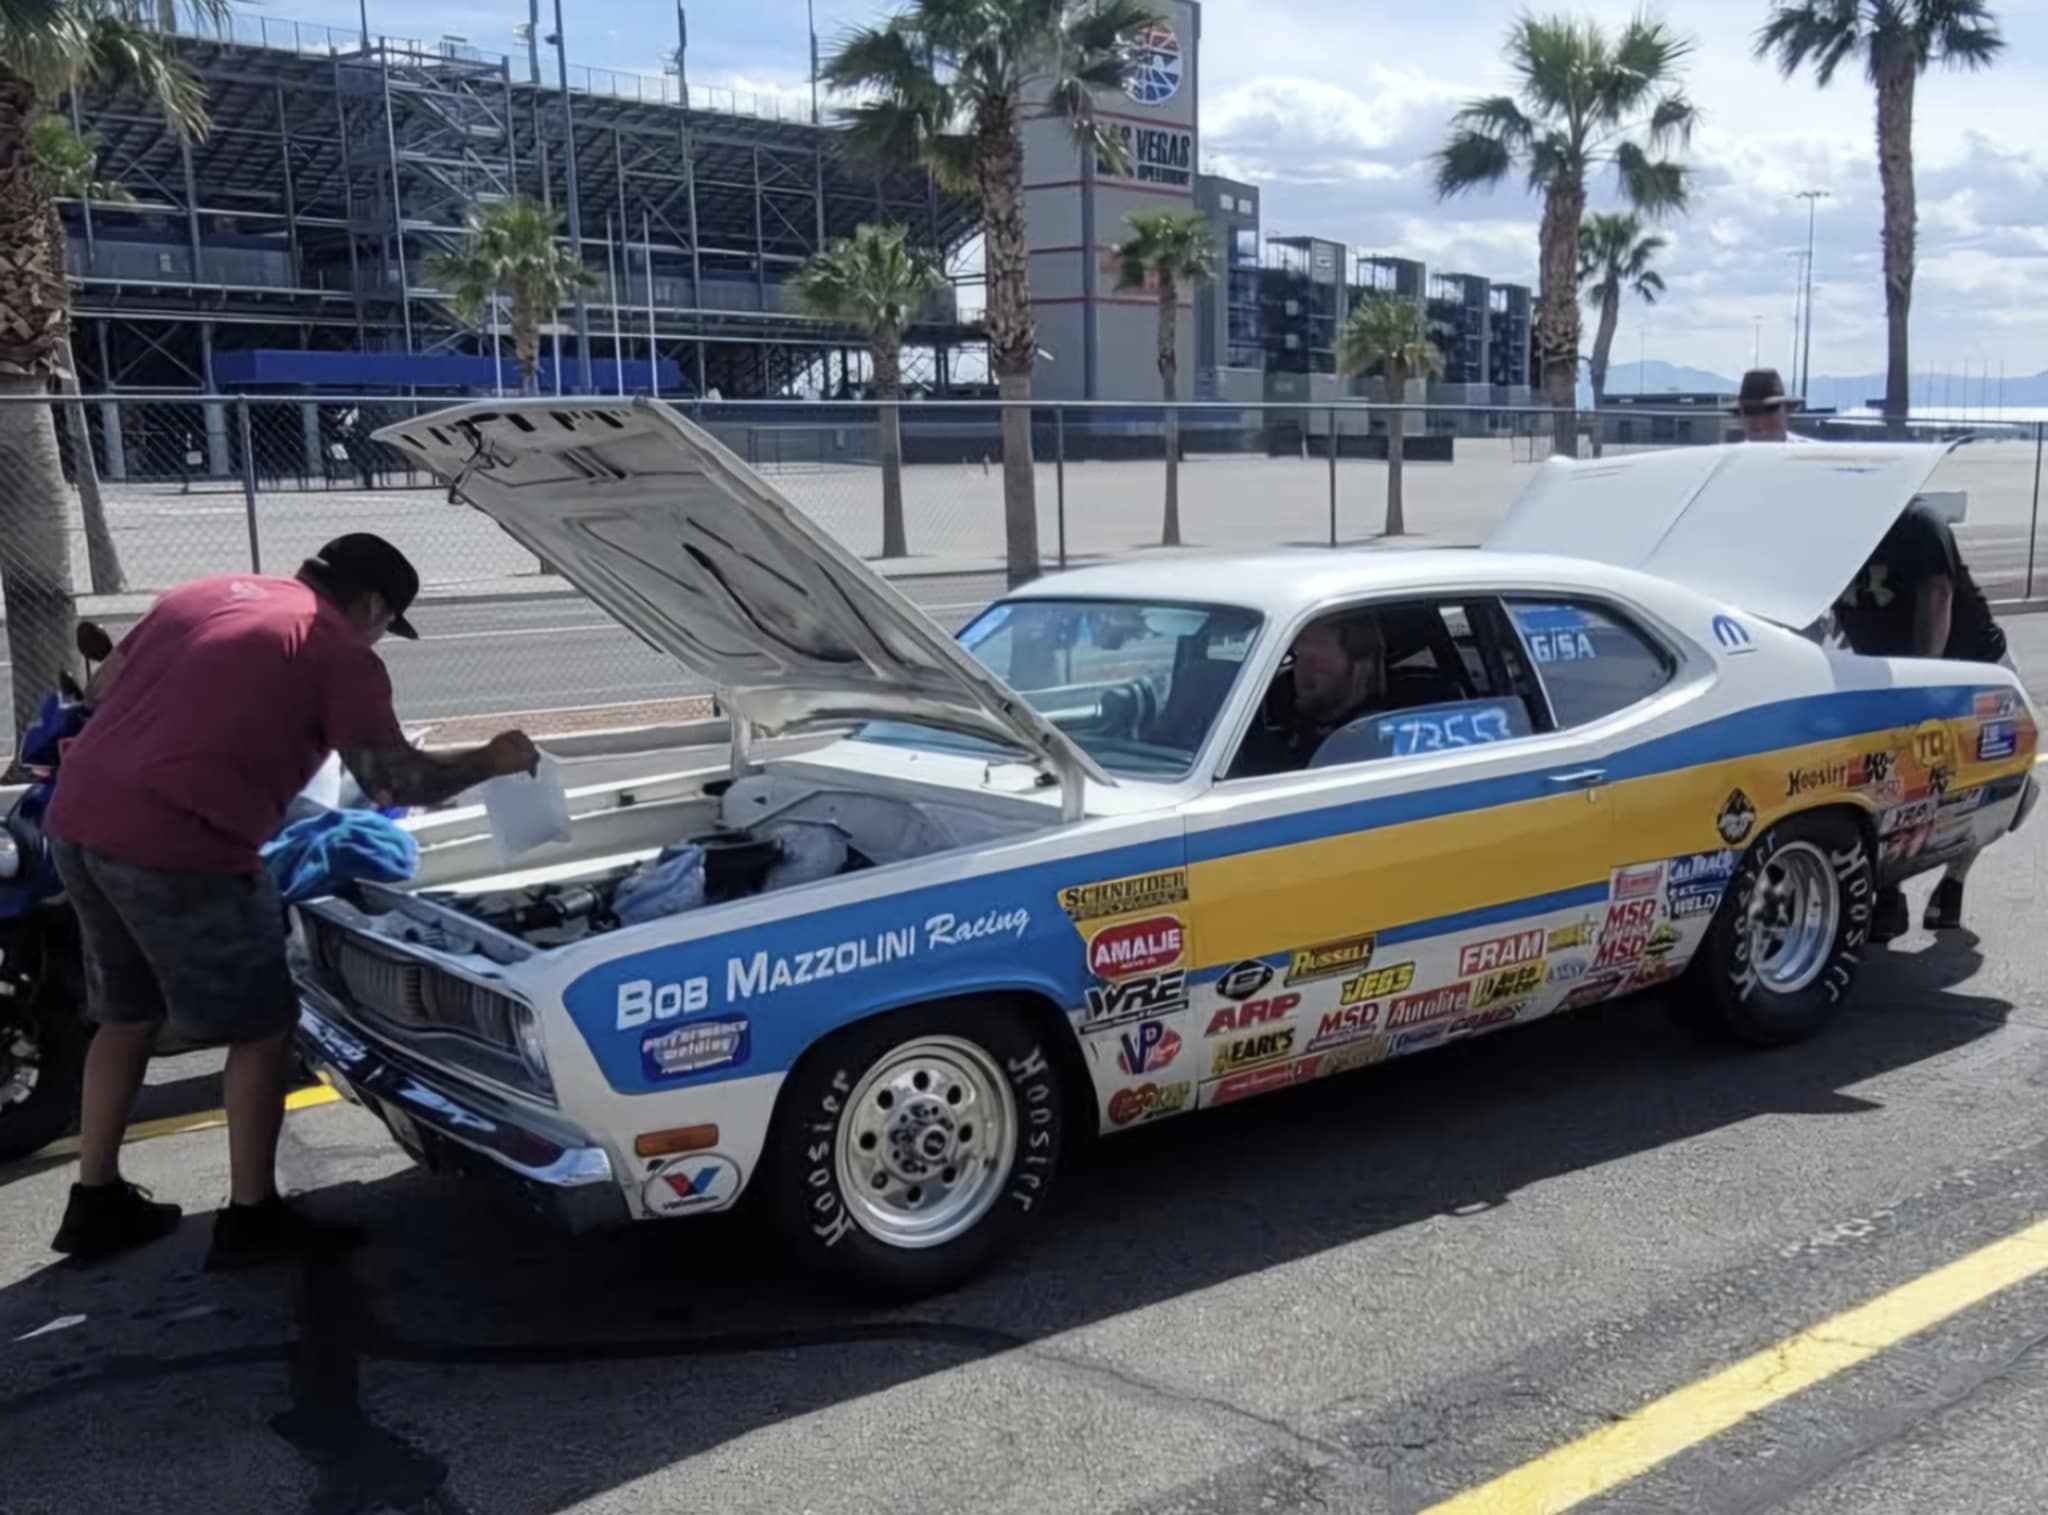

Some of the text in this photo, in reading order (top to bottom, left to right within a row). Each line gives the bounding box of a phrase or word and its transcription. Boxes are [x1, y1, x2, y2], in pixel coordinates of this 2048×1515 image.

[1137, 128, 1190, 168] VEGAS
[1094, 928, 1181, 968] AMALIE
[1461, 931, 1543, 975] FRAM
[616, 977, 708, 1031] BOB
[727, 925, 916, 1003] MAZZOLINI
[924, 907, 1031, 951] Racing
[1204, 993, 1301, 1038] ARP
[1316, 1002, 1379, 1040] MSD
[1388, 990, 1469, 1027] Autolite
